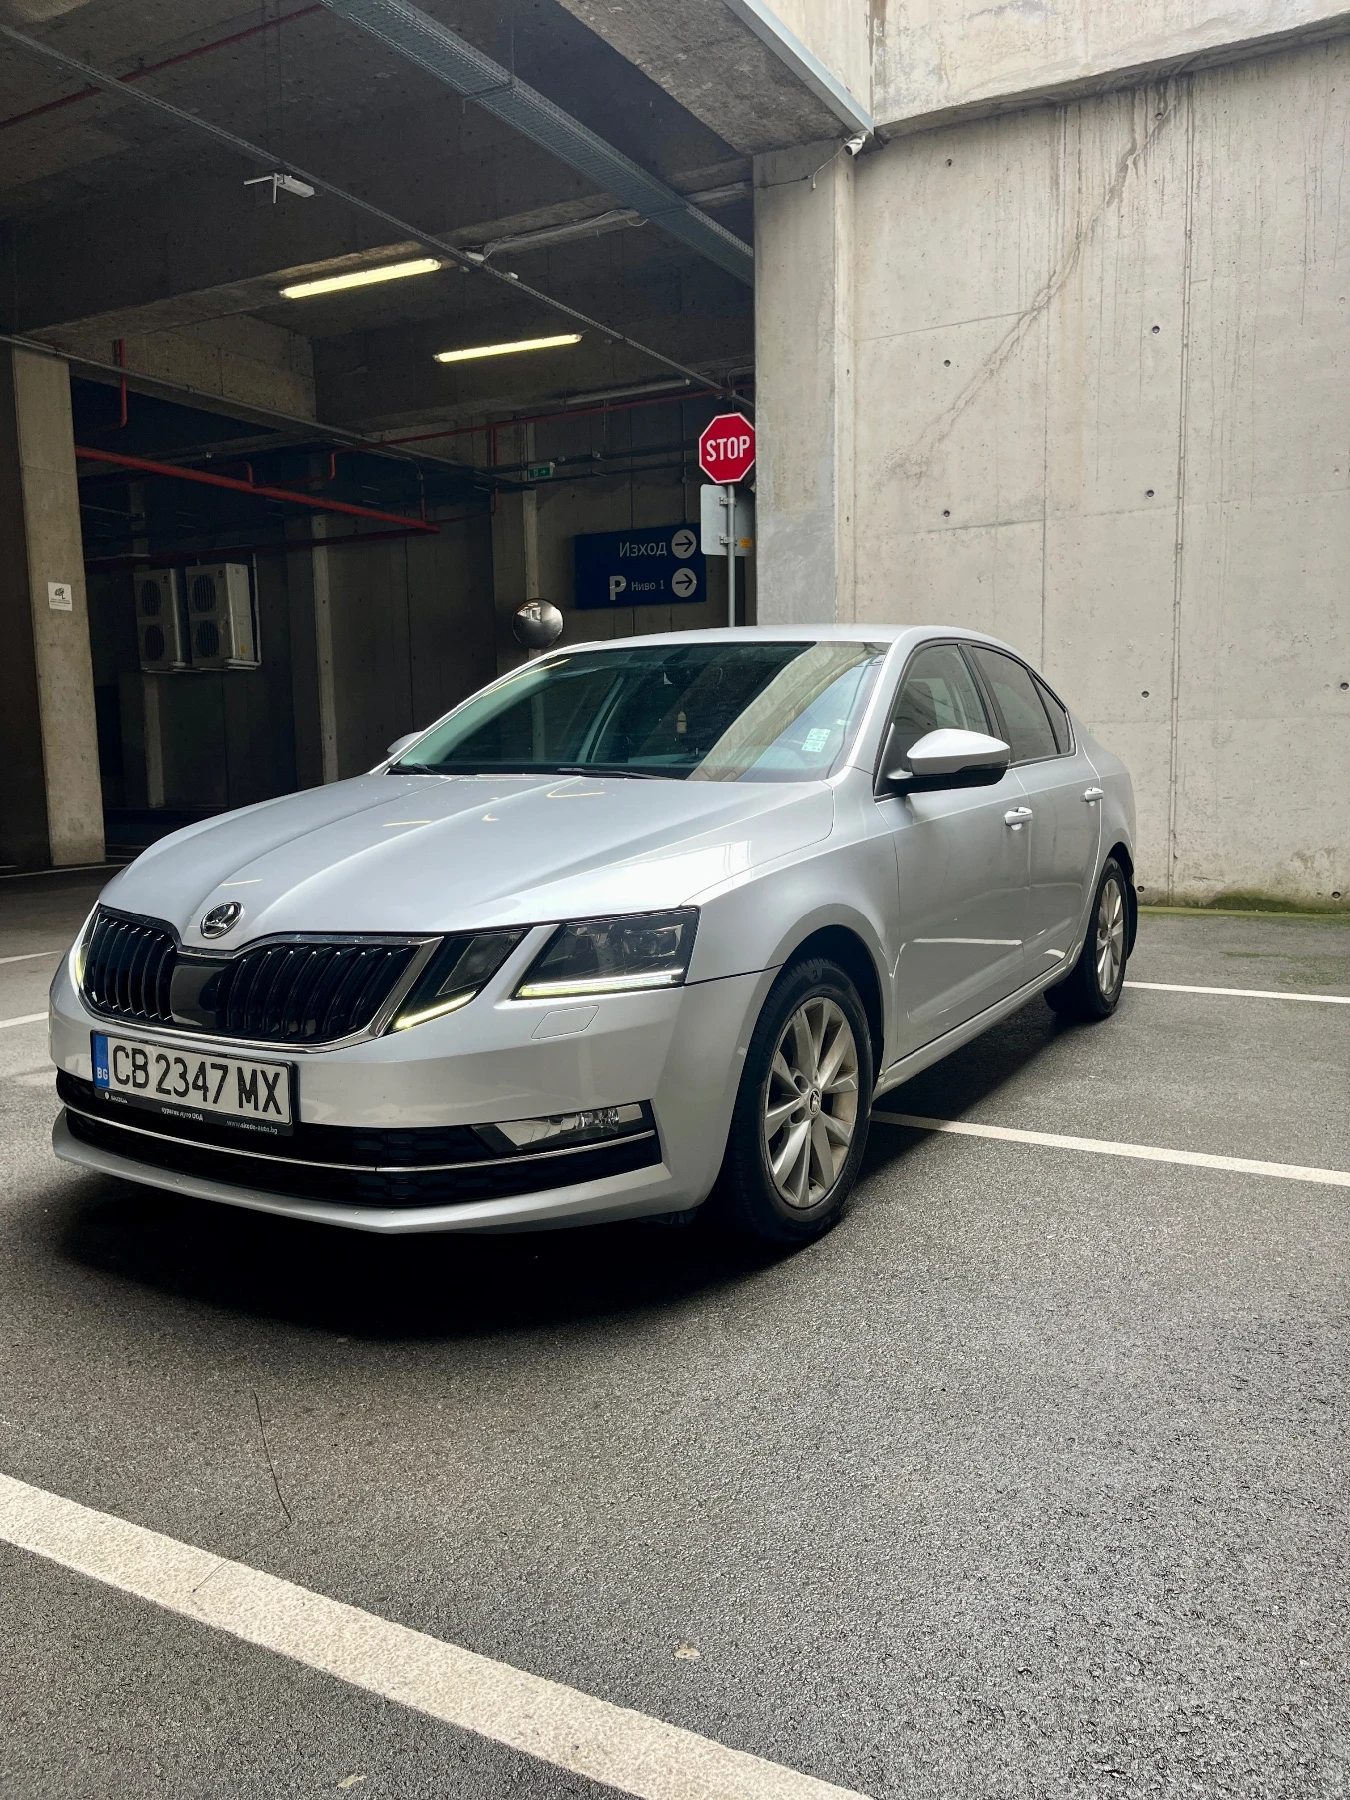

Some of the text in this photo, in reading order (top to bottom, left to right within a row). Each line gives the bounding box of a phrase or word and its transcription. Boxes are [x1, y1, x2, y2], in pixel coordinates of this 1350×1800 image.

[706, 435, 751, 462] STOP
[619, 541, 667, 558] Изход
[631, 580, 656, 592] Ниво
[659, 580, 665, 590] 1
[96, 1066, 109, 1080] BG
[112, 1044, 283, 1116] CB 2347 MX
